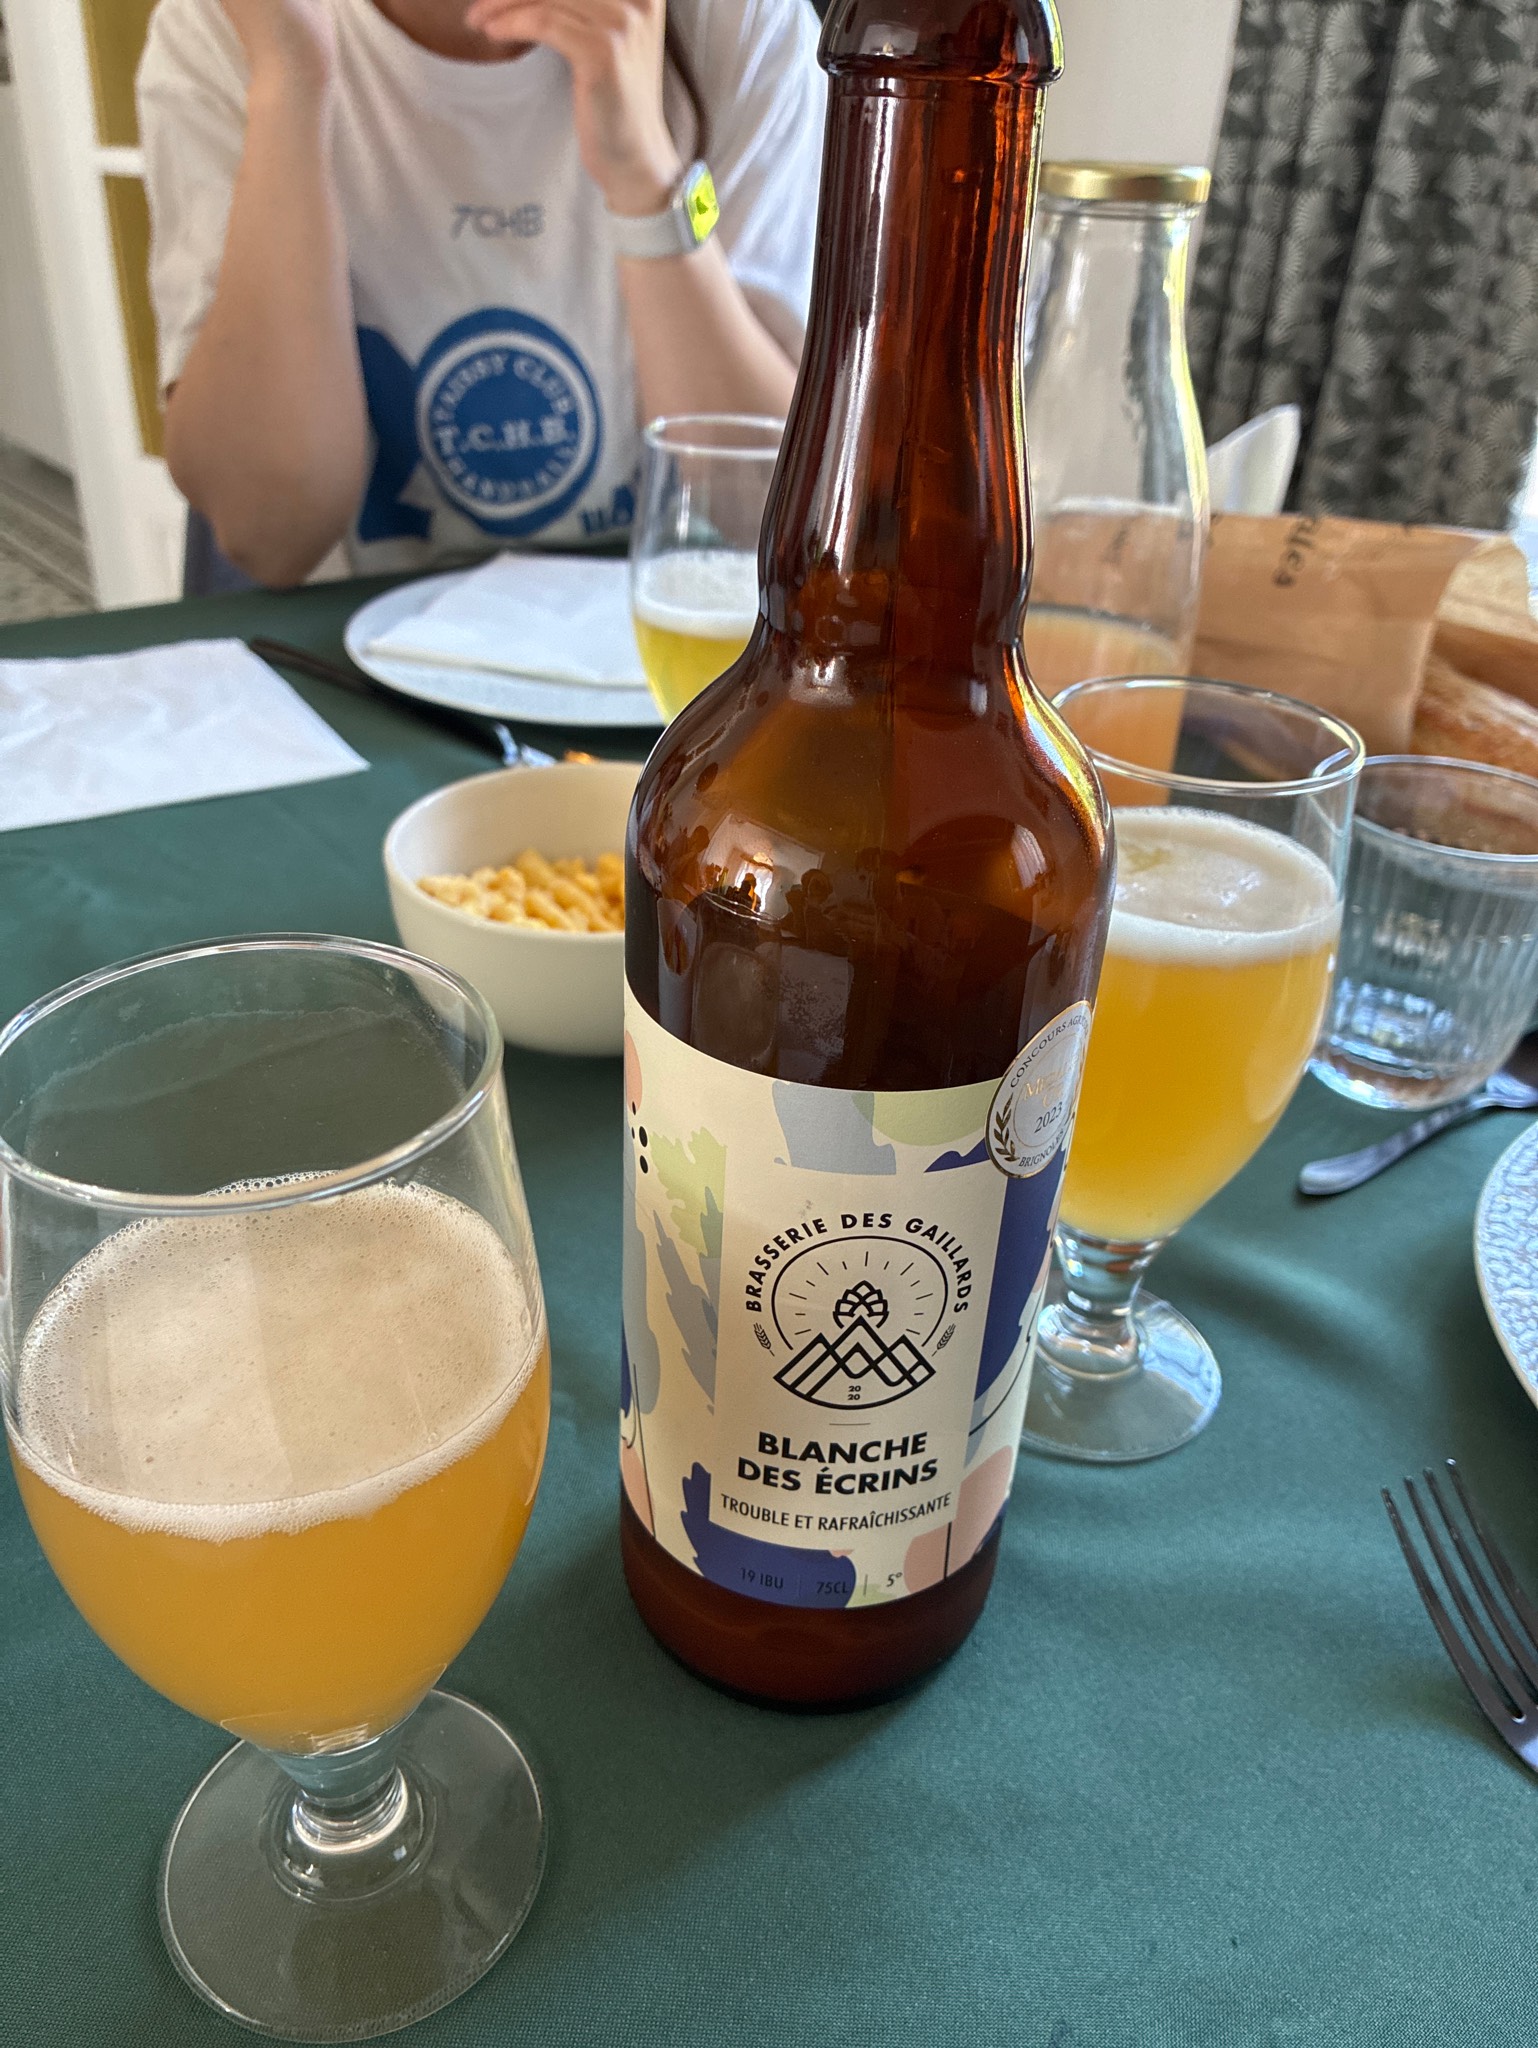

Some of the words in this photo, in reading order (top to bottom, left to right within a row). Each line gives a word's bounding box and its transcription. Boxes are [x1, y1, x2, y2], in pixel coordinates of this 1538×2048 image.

[1010, 1022, 1067, 1088] CONCOURS
[1034, 1101, 1063, 1133] 2023
[1018, 1128, 1064, 1167] BRIGNOLES
[745, 1217, 828, 1313] BRASSERIE
[840, 1212, 893, 1230] DES
[904, 1217, 973, 1314] GAILLARDS
[847, 1393, 861, 1401] 20
[848, 1385, 862, 1393] 20
[758, 1431, 928, 1464] BLANCHE
[737, 1457, 801, 1491] DES
[815, 1459, 938, 1495] ÉCRINS
[721, 1493, 789, 1527] TROUBLE
[794, 1514, 814, 1530] ET
[818, 1492, 952, 1531] RAFRAÎCHISSANTE
[741, 1566, 756, 1583] 19
[759, 1572, 784, 1590] IBU
[816, 1581, 849, 1594] 75CL
